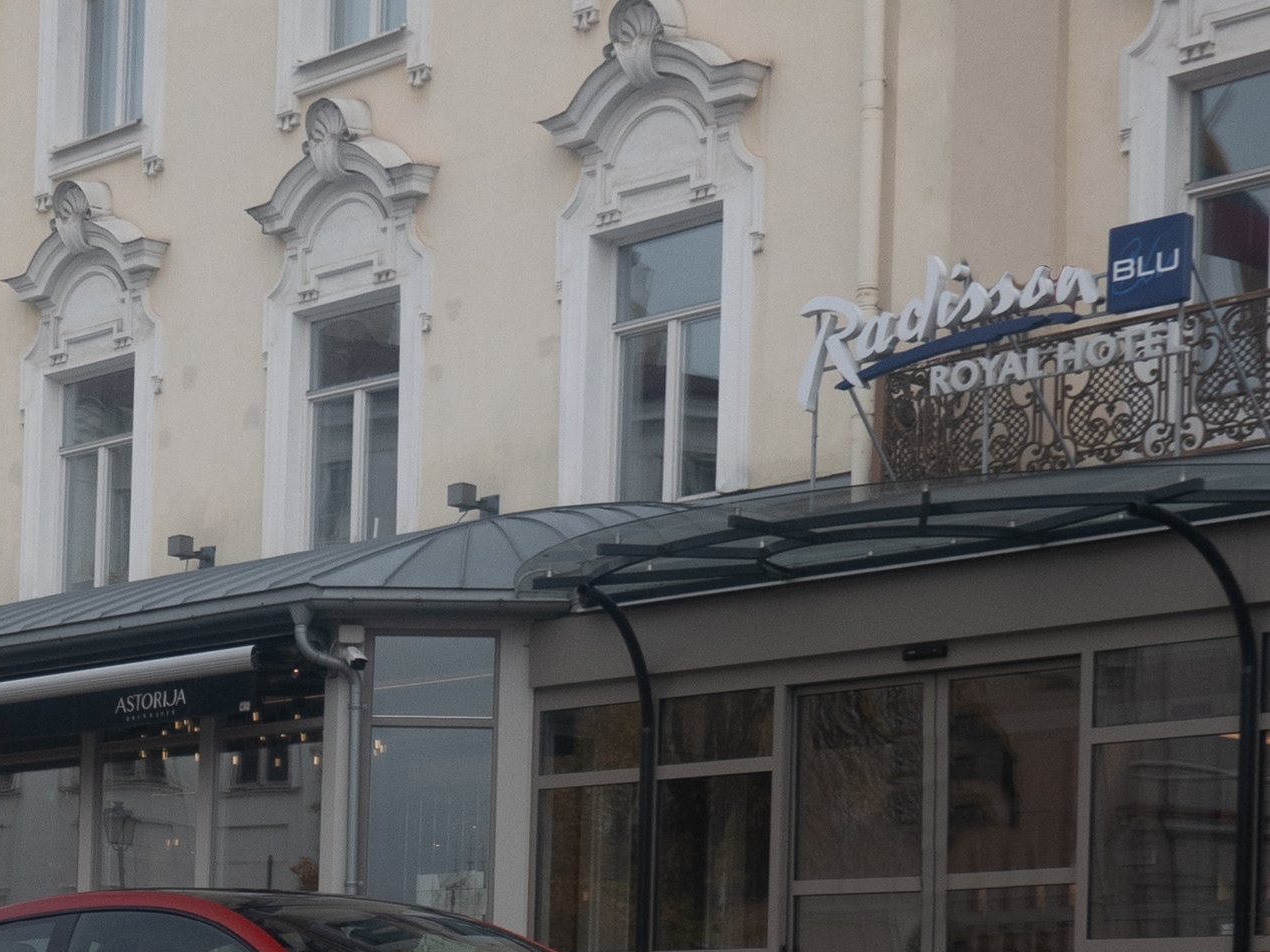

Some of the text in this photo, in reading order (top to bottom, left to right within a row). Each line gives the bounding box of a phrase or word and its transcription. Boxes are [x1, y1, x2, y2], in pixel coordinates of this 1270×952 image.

[1112, 248, 1180, 283] BLU
[797, 254, 1102, 413] Radisson
[929, 319, 1191, 398] ROYAL HOTEL
[115, 688, 187, 714] ASTORIJA
